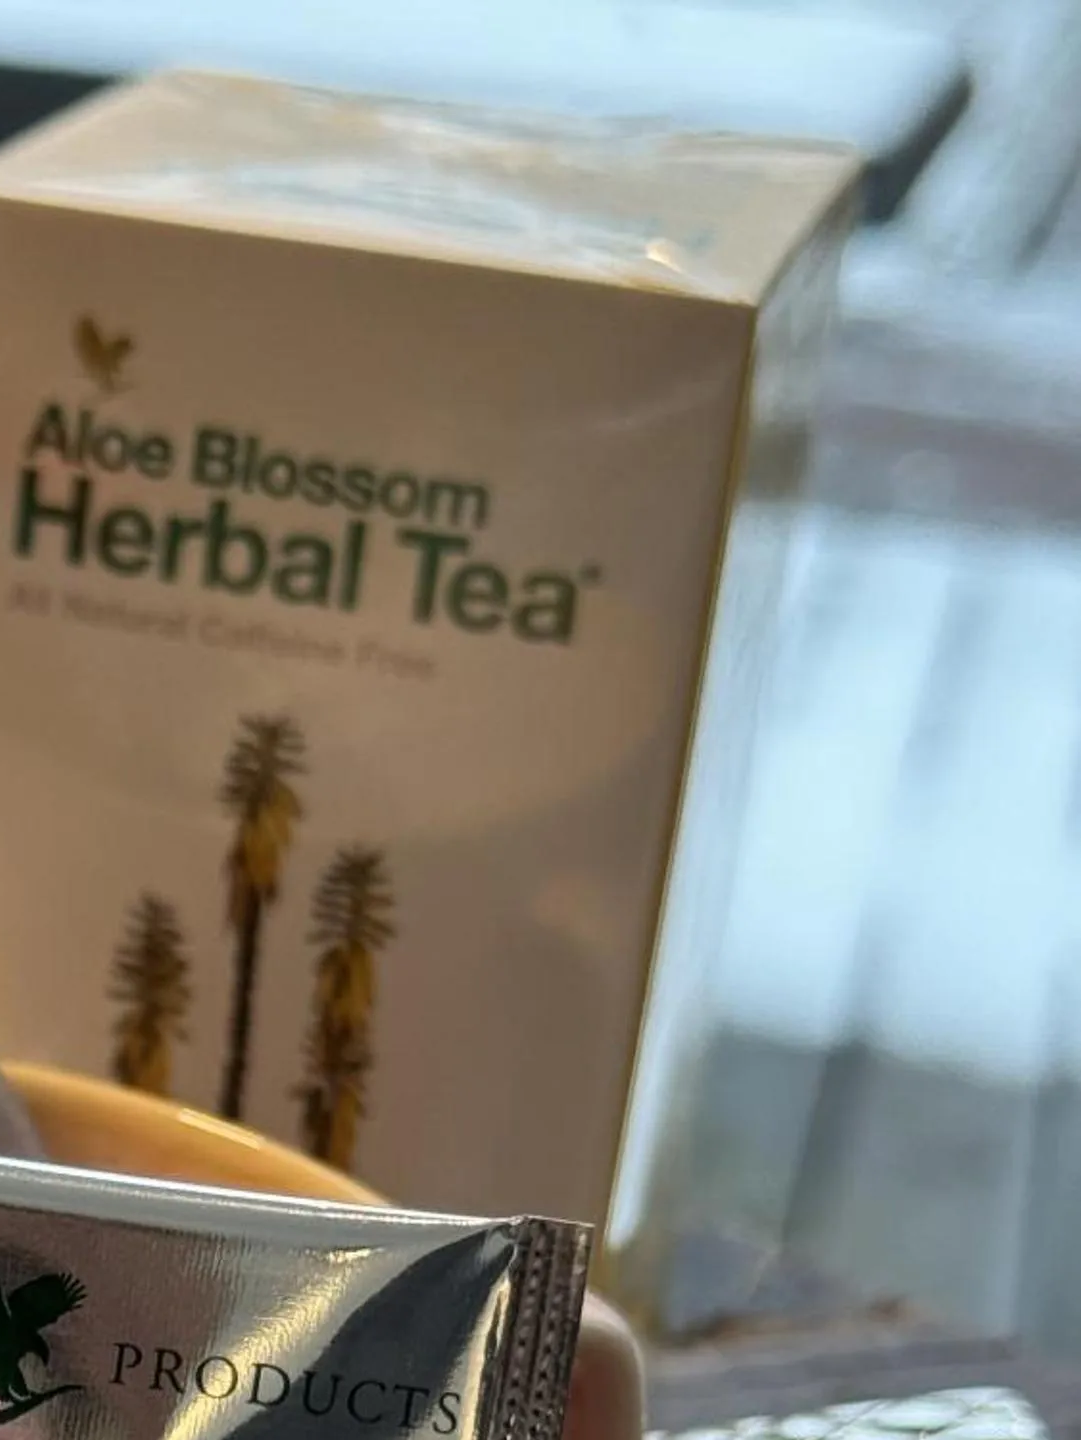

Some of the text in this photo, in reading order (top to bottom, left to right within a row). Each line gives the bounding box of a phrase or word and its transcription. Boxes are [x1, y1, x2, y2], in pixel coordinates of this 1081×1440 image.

[27, 404, 490, 529] Aloe Blossom
[13, 468, 370, 613] Herbal
[110, 1342, 463, 1435] PRODUCTS
